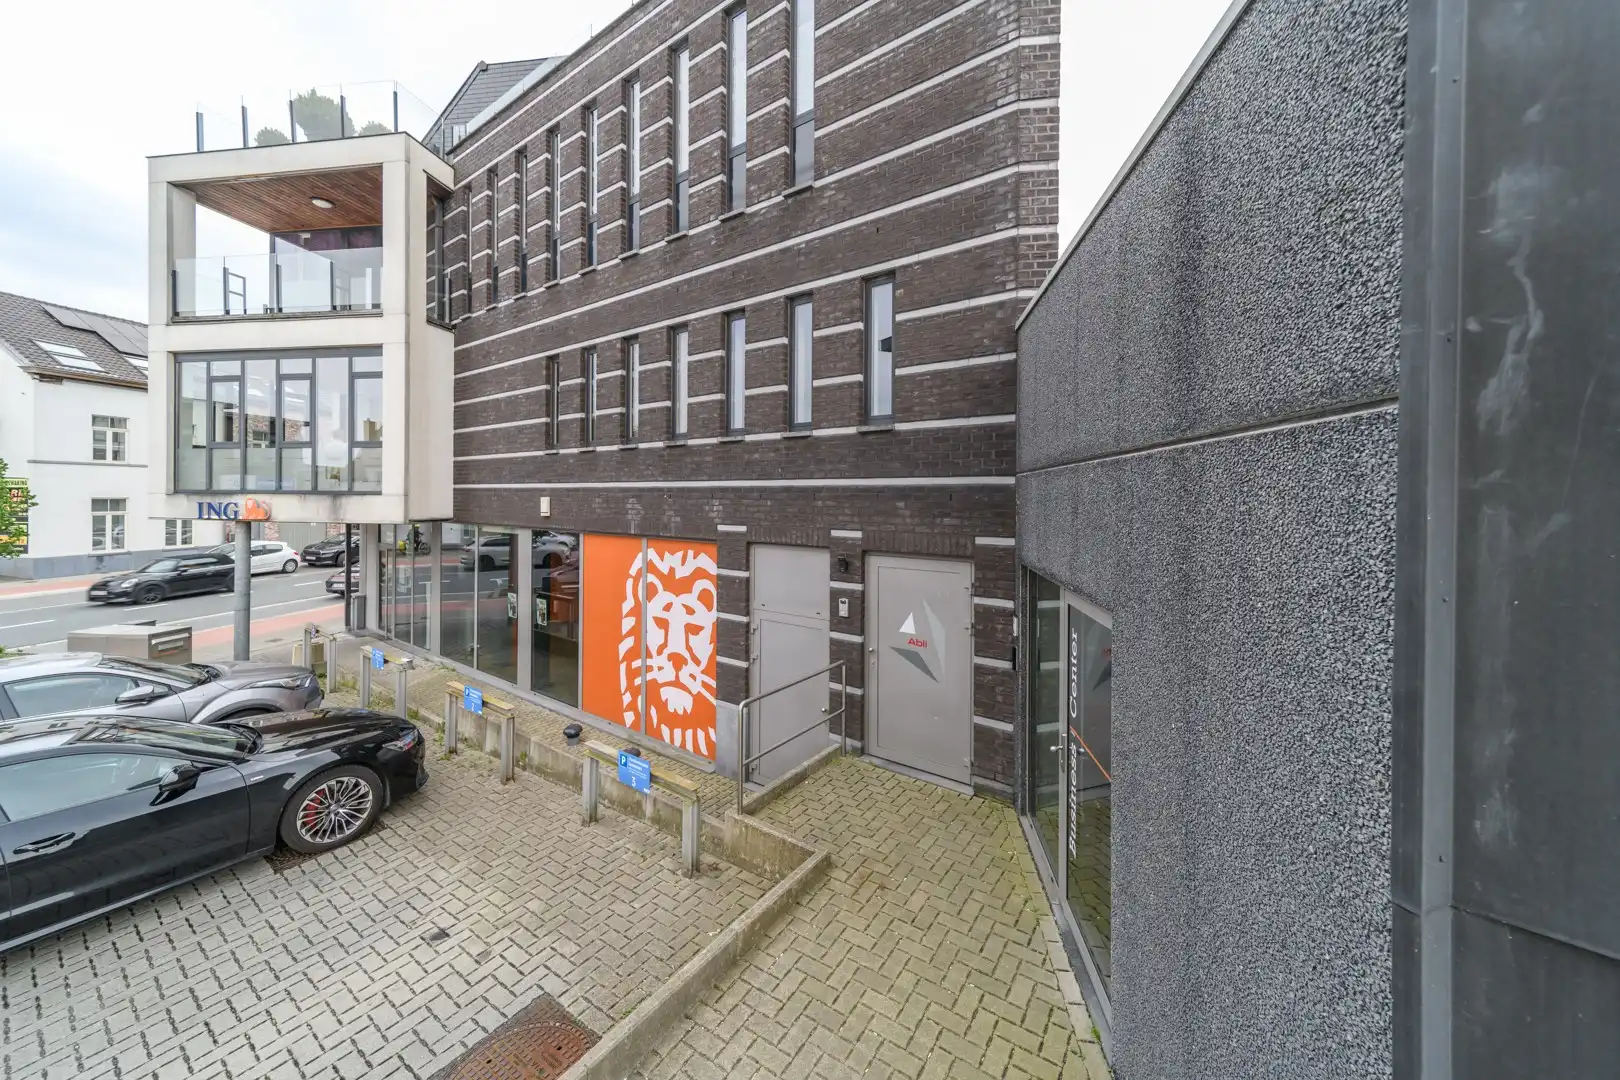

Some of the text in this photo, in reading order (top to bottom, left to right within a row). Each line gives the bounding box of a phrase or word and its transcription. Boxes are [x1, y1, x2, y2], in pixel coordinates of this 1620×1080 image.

[196, 501, 240, 520] ING
[471, 702, 475, 712] 2
[1069, 627, 1078, 860] Business Center
[621, 755, 626, 765] P
[631, 776, 637, 787] 3
